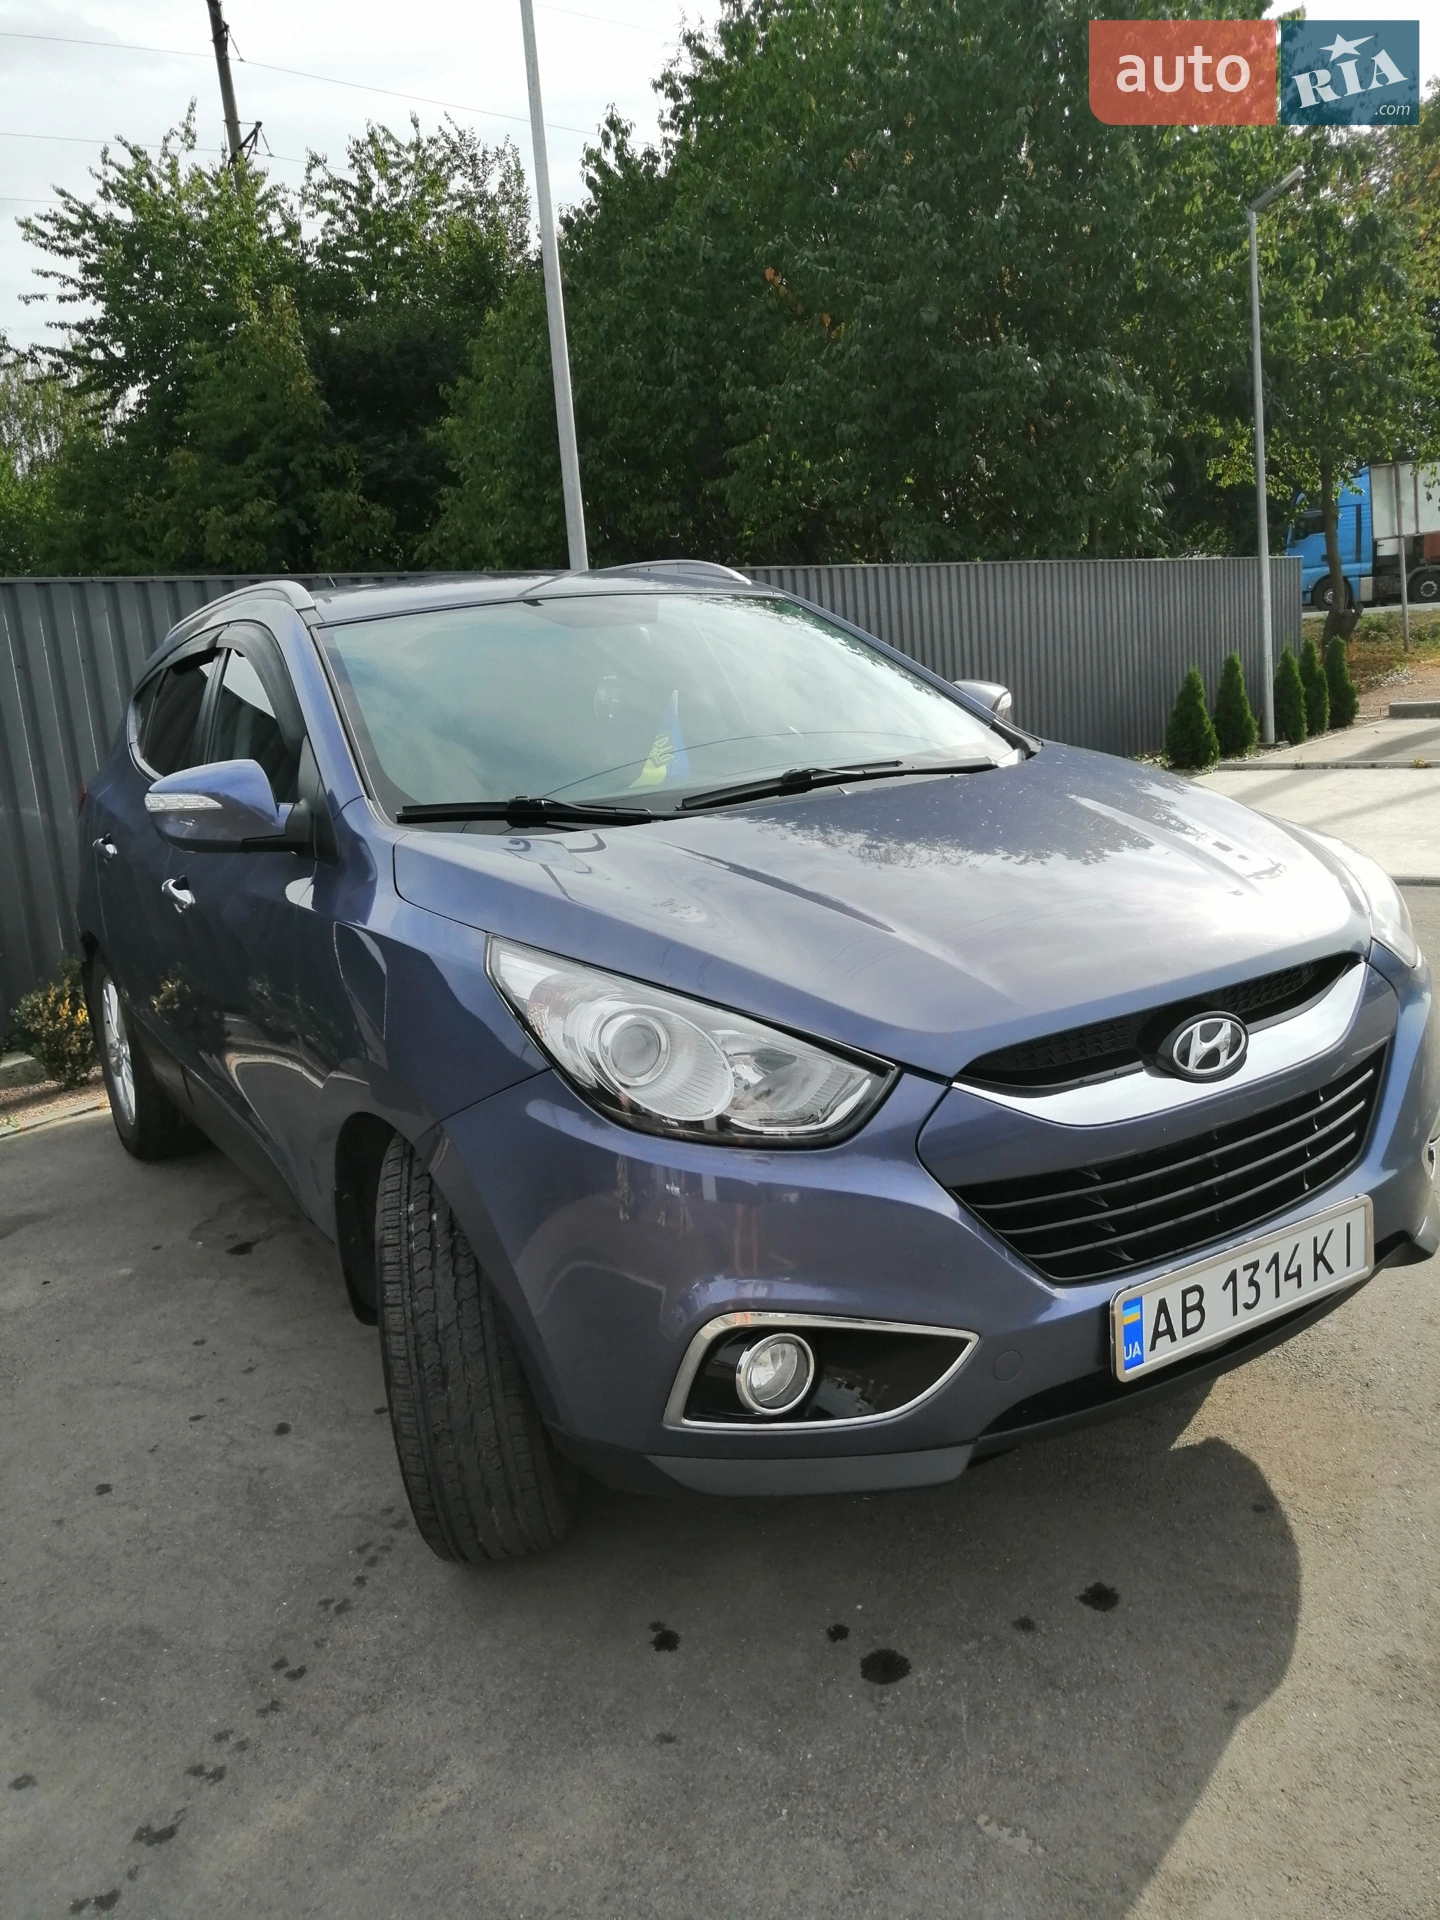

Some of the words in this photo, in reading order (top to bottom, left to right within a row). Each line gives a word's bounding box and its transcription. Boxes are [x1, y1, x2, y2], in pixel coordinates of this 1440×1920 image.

[1149, 1283, 1206, 1352] AB
[1222, 1242, 1302, 1317] 1314
[1312, 1221, 1351, 1282] KI
[1123, 1341, 1142, 1361] UA
